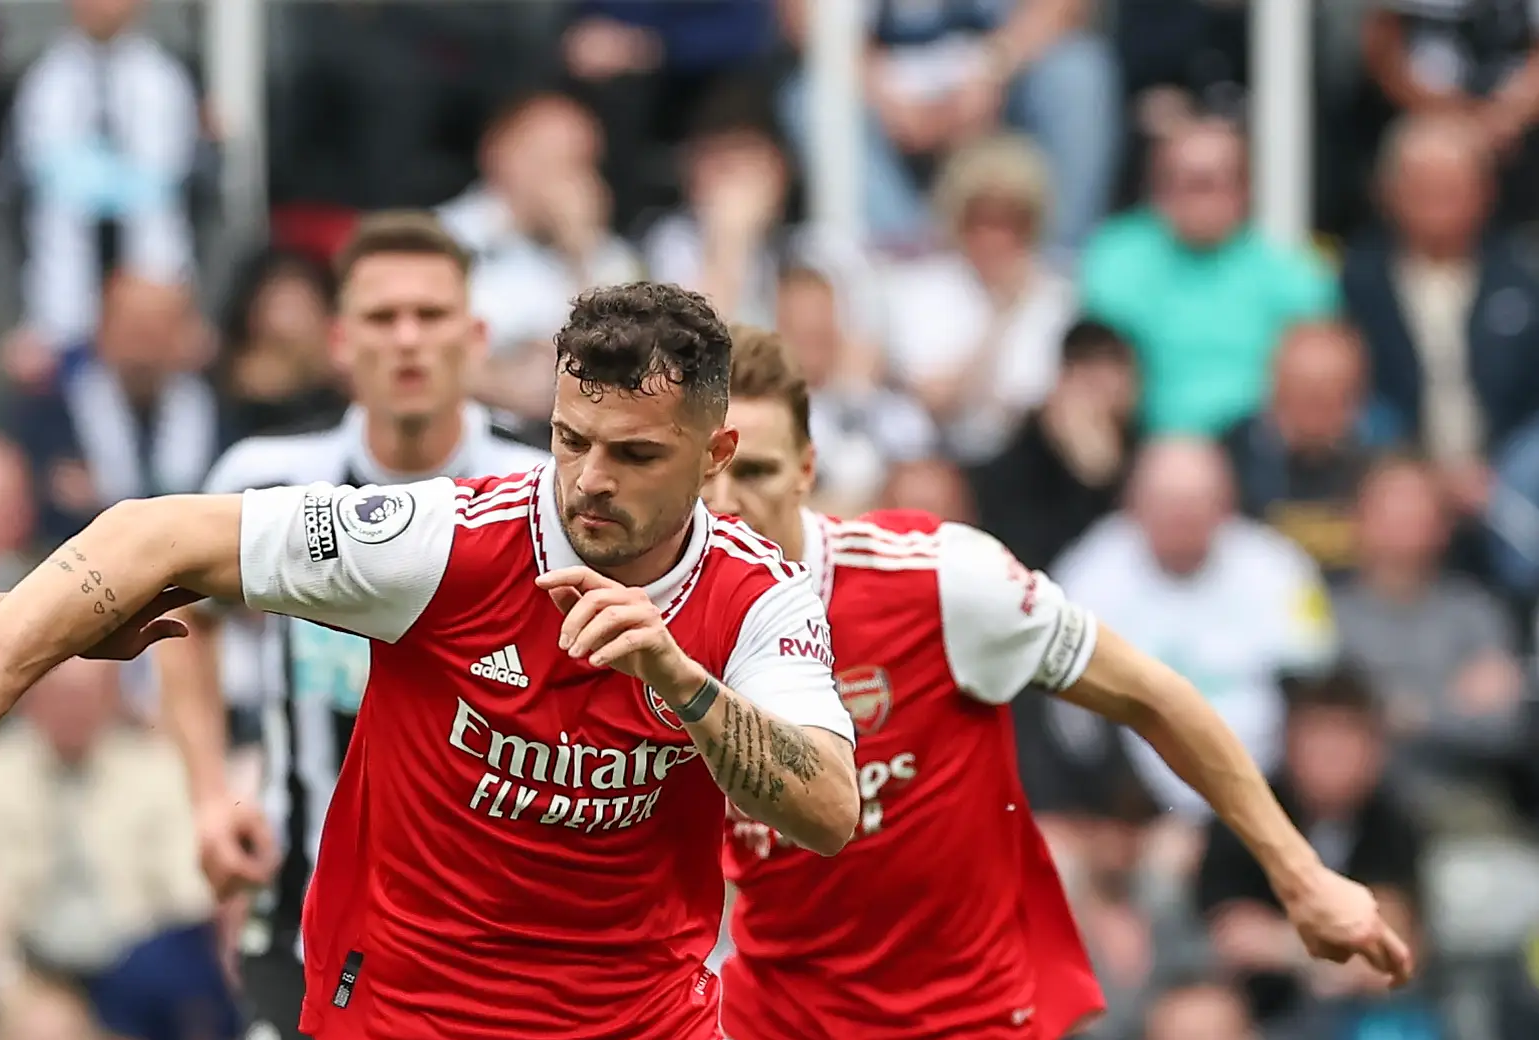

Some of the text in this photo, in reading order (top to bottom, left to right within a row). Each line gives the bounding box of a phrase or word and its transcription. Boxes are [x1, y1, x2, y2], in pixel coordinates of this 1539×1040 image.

[305, 507, 324, 561] racism
[318, 507, 335, 552] room
[470, 662, 529, 688] adidas
[469, 773, 662, 833] FLY BETTER
